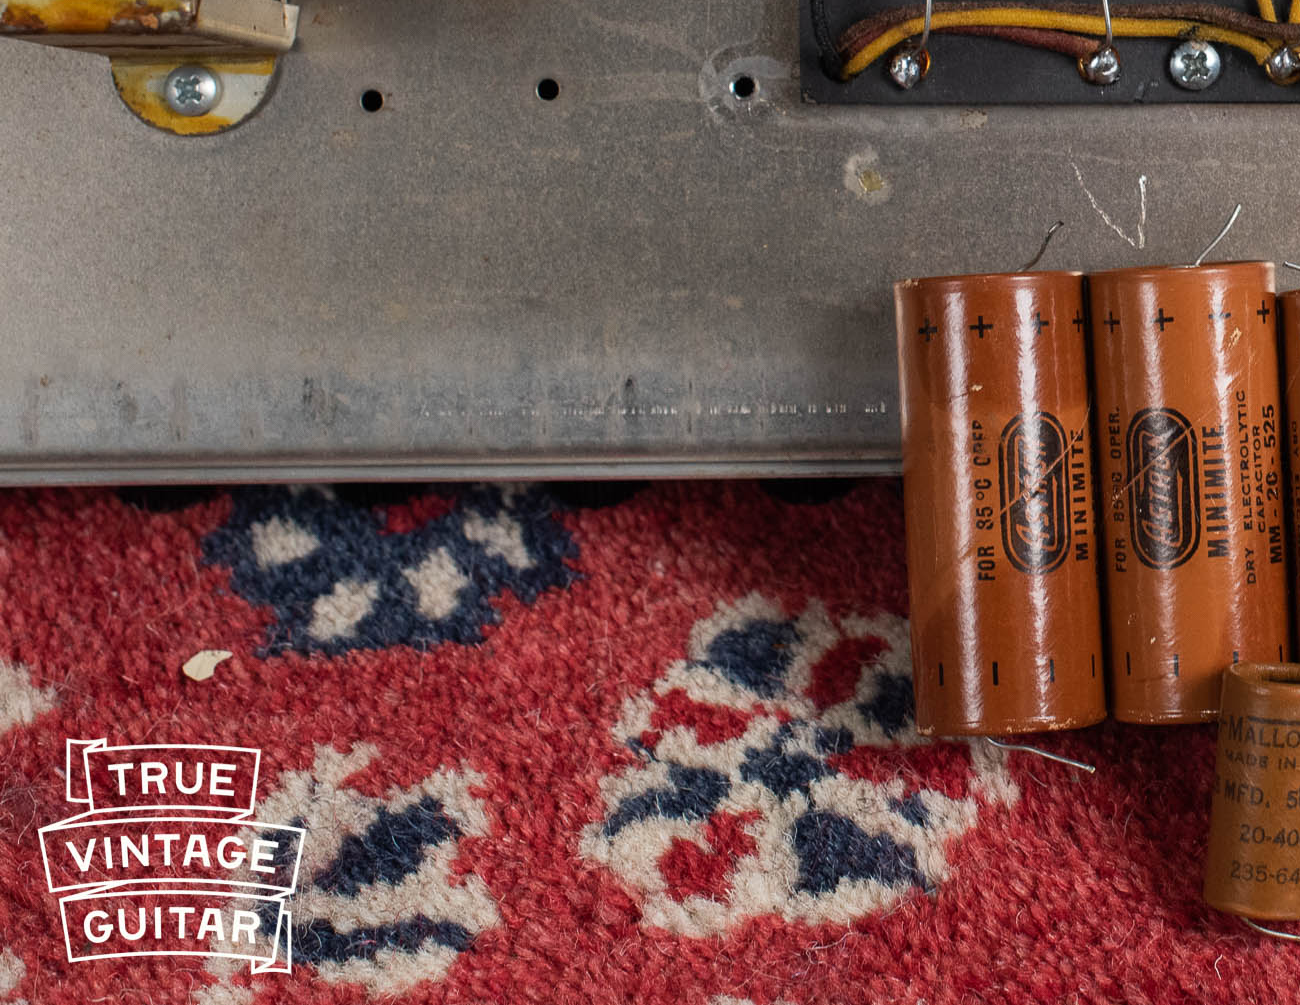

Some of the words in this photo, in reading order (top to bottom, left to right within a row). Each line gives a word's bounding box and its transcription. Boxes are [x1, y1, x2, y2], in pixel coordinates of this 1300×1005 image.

[1108, 406, 1121, 459] OPER.
[1235, 390, 1252, 530] ELECTROLYTIC
[1252, 425, 1266, 533] CAPACITOR
[1070, 429, 1088, 561] MINIMITE
[1202, 425, 1230, 558] MINIMITE
[977, 546, 995, 580] FOR
[1115, 538, 1126, 572] FOR
[1243, 547, 1257, 584] DRY
[1278, 756, 1297, 771] IN
